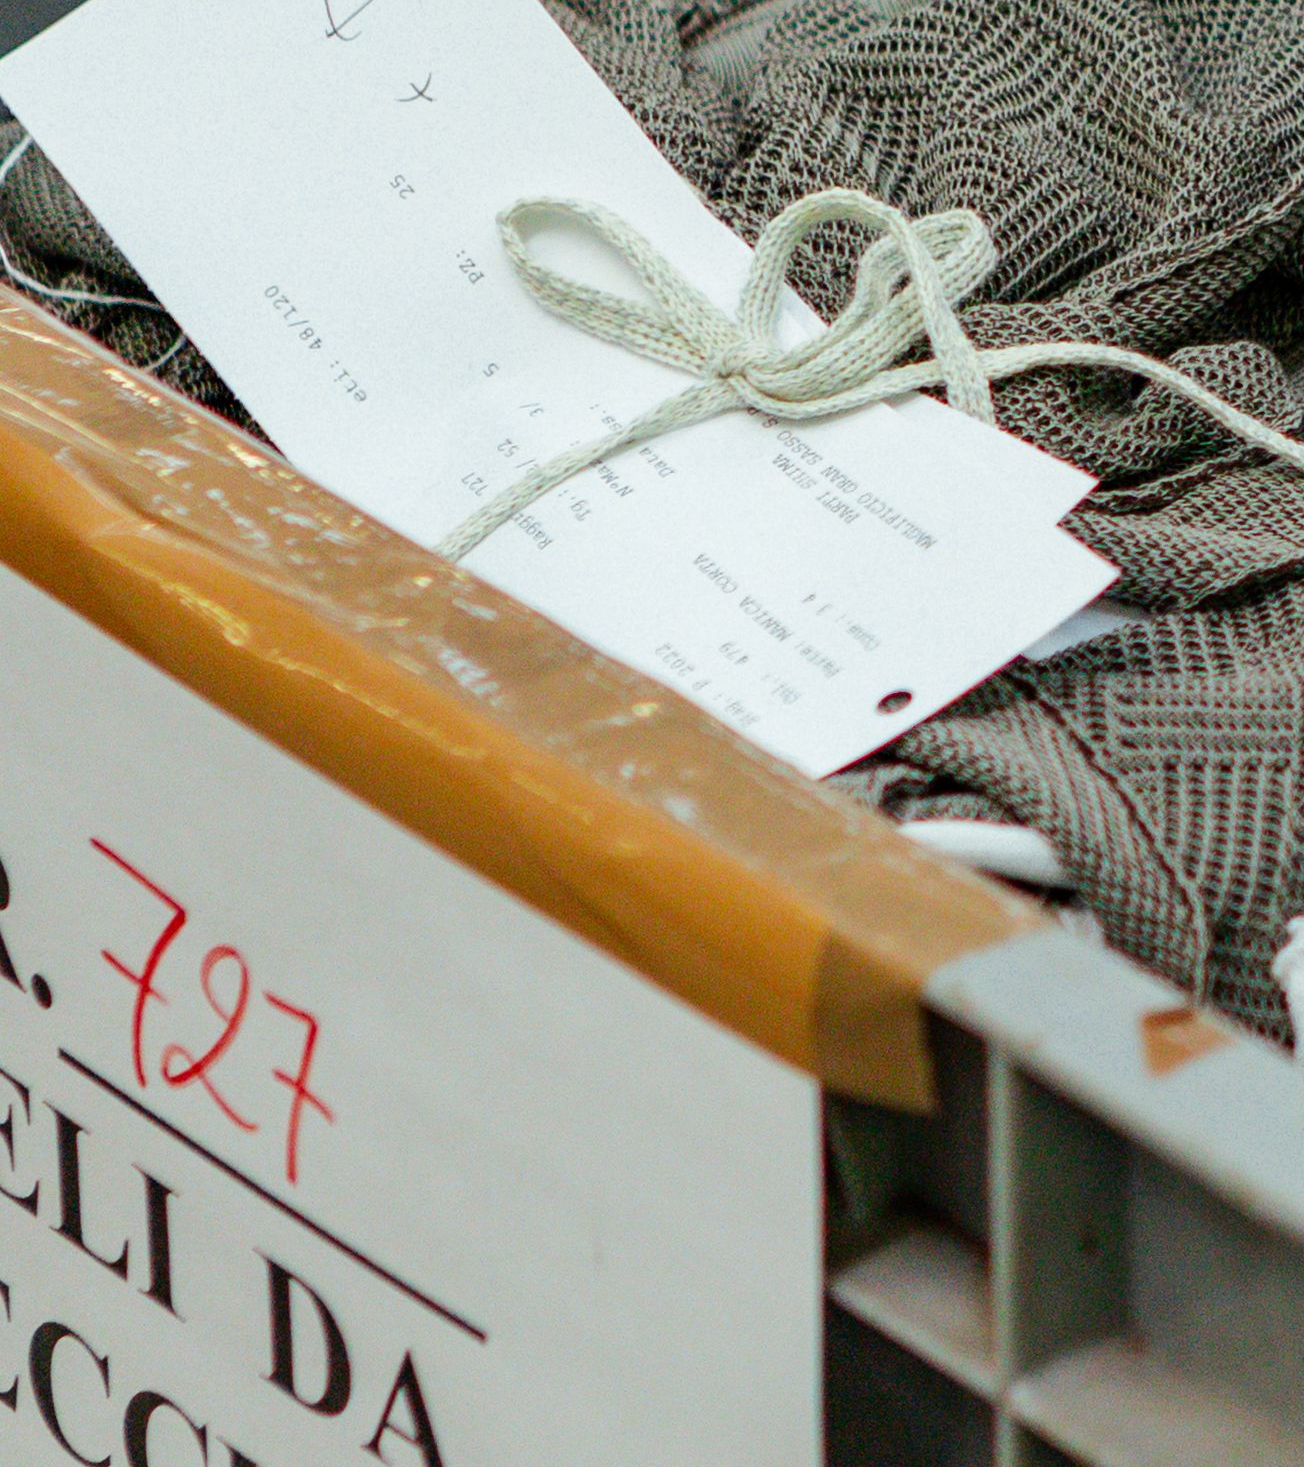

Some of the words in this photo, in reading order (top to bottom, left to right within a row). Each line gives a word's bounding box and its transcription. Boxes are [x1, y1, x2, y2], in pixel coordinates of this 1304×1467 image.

[389, 173, 416, 200] 25
[455, 249, 486, 285] PZ:
[263, 284, 323, 350] 48/120
[329, 359, 368, 403] eti:
[482, 362, 500, 378] 5
[496, 437, 519, 458] 52
[637, 443, 676, 478] Data
[775, 426, 823, 467] SASSO
[460, 471, 489, 497] 727
[771, 452, 818, 489] SHIMA
[819, 464, 859, 494] GRAN
[557, 489, 592, 522] Tg.:
[815, 490, 861, 525] PARTI
[738, 595, 793, 643] MANICA
[654, 642, 696, 677] 2022
[89, 836, 334, 1188] 727
